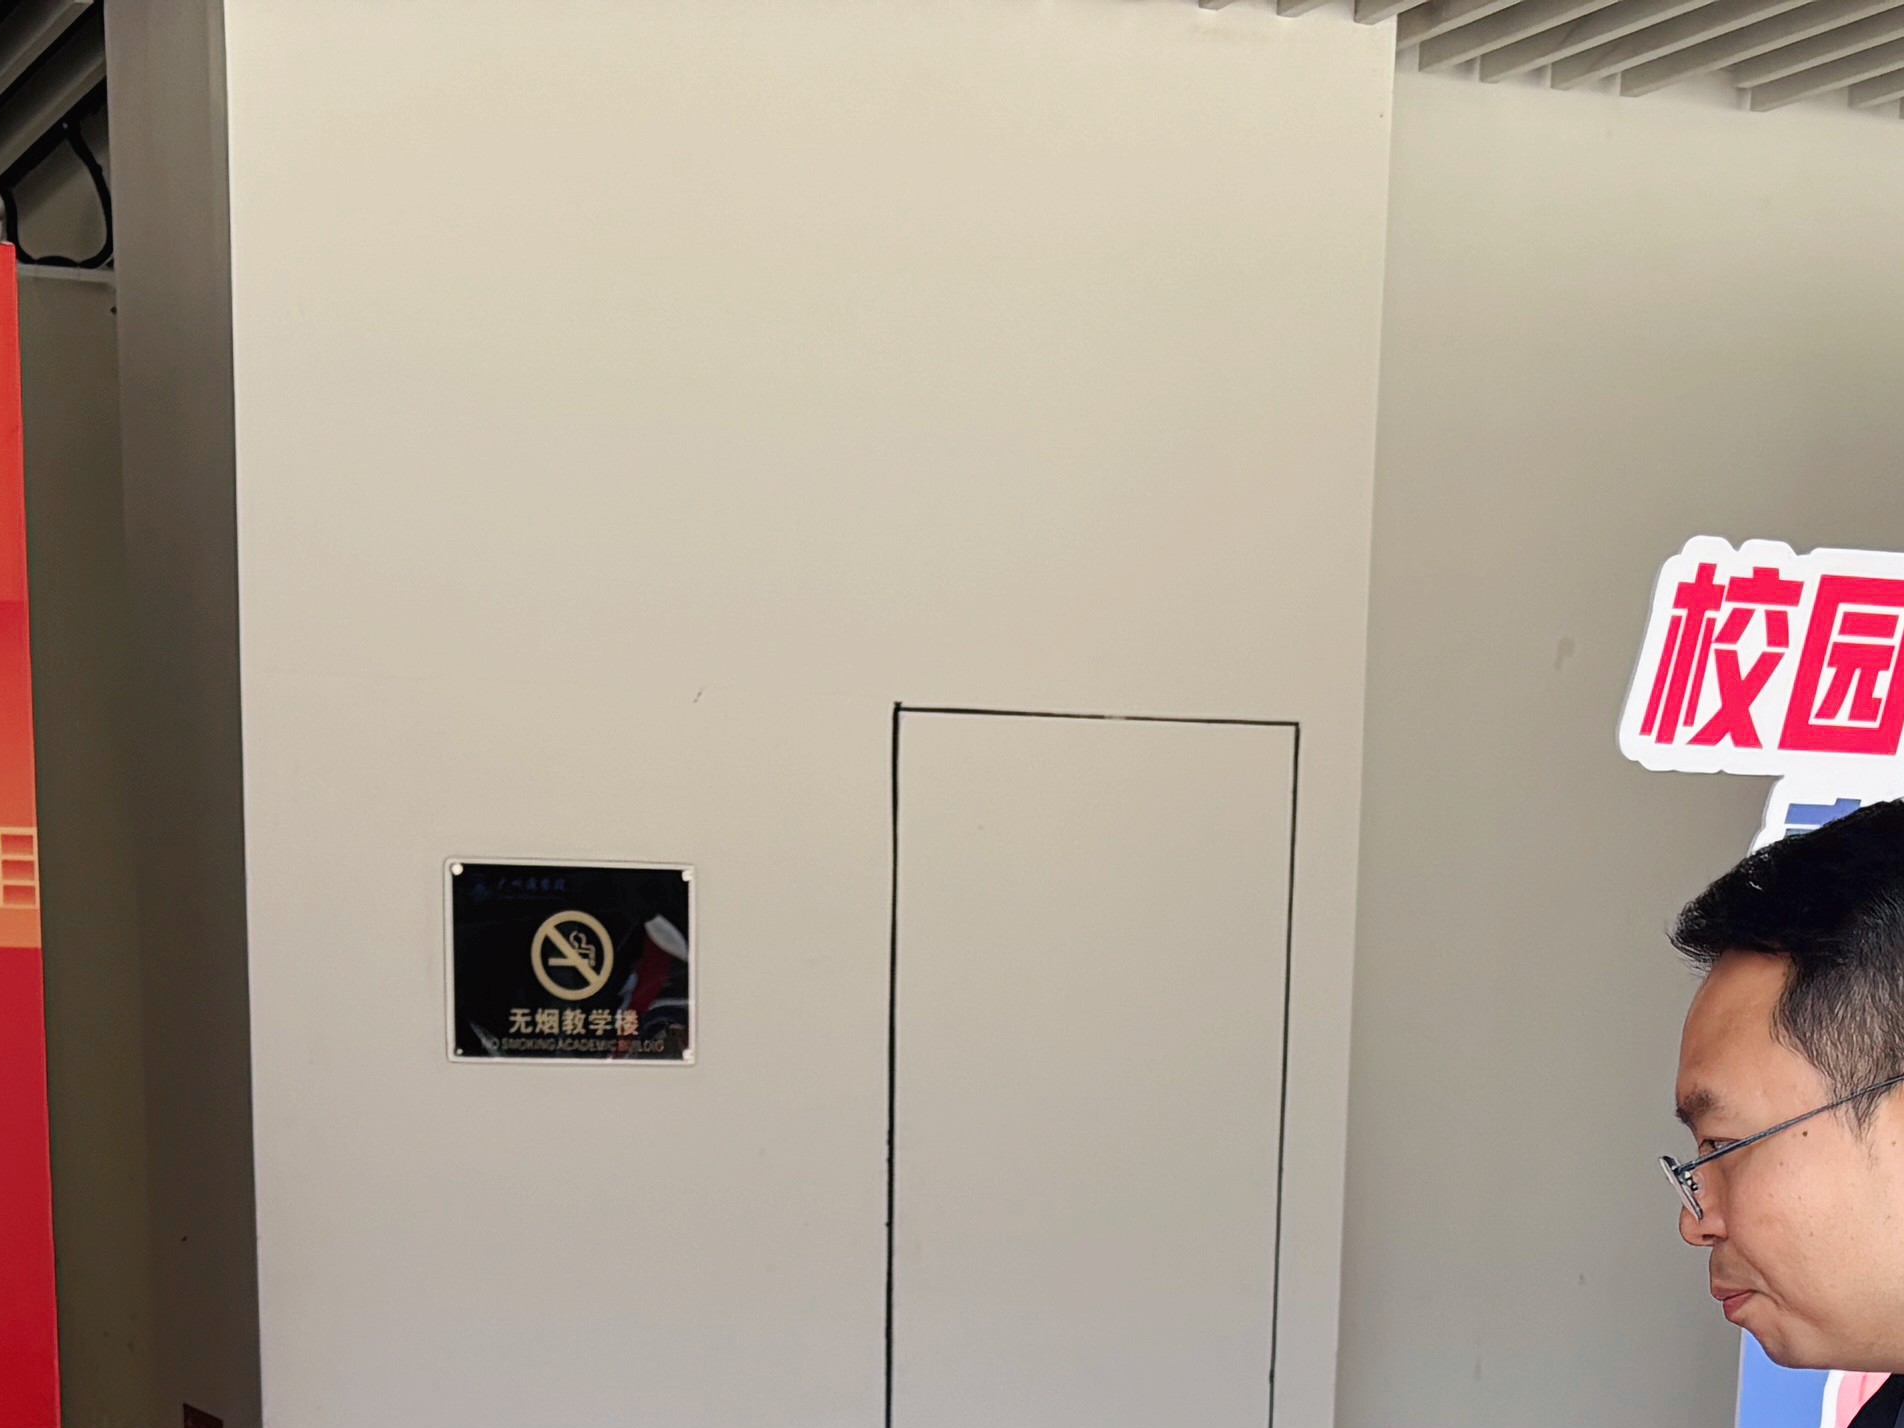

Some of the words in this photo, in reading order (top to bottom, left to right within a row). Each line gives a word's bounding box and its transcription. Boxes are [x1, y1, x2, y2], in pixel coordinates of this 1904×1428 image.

[508, 1008, 640, 1036] 无烟教学楼
